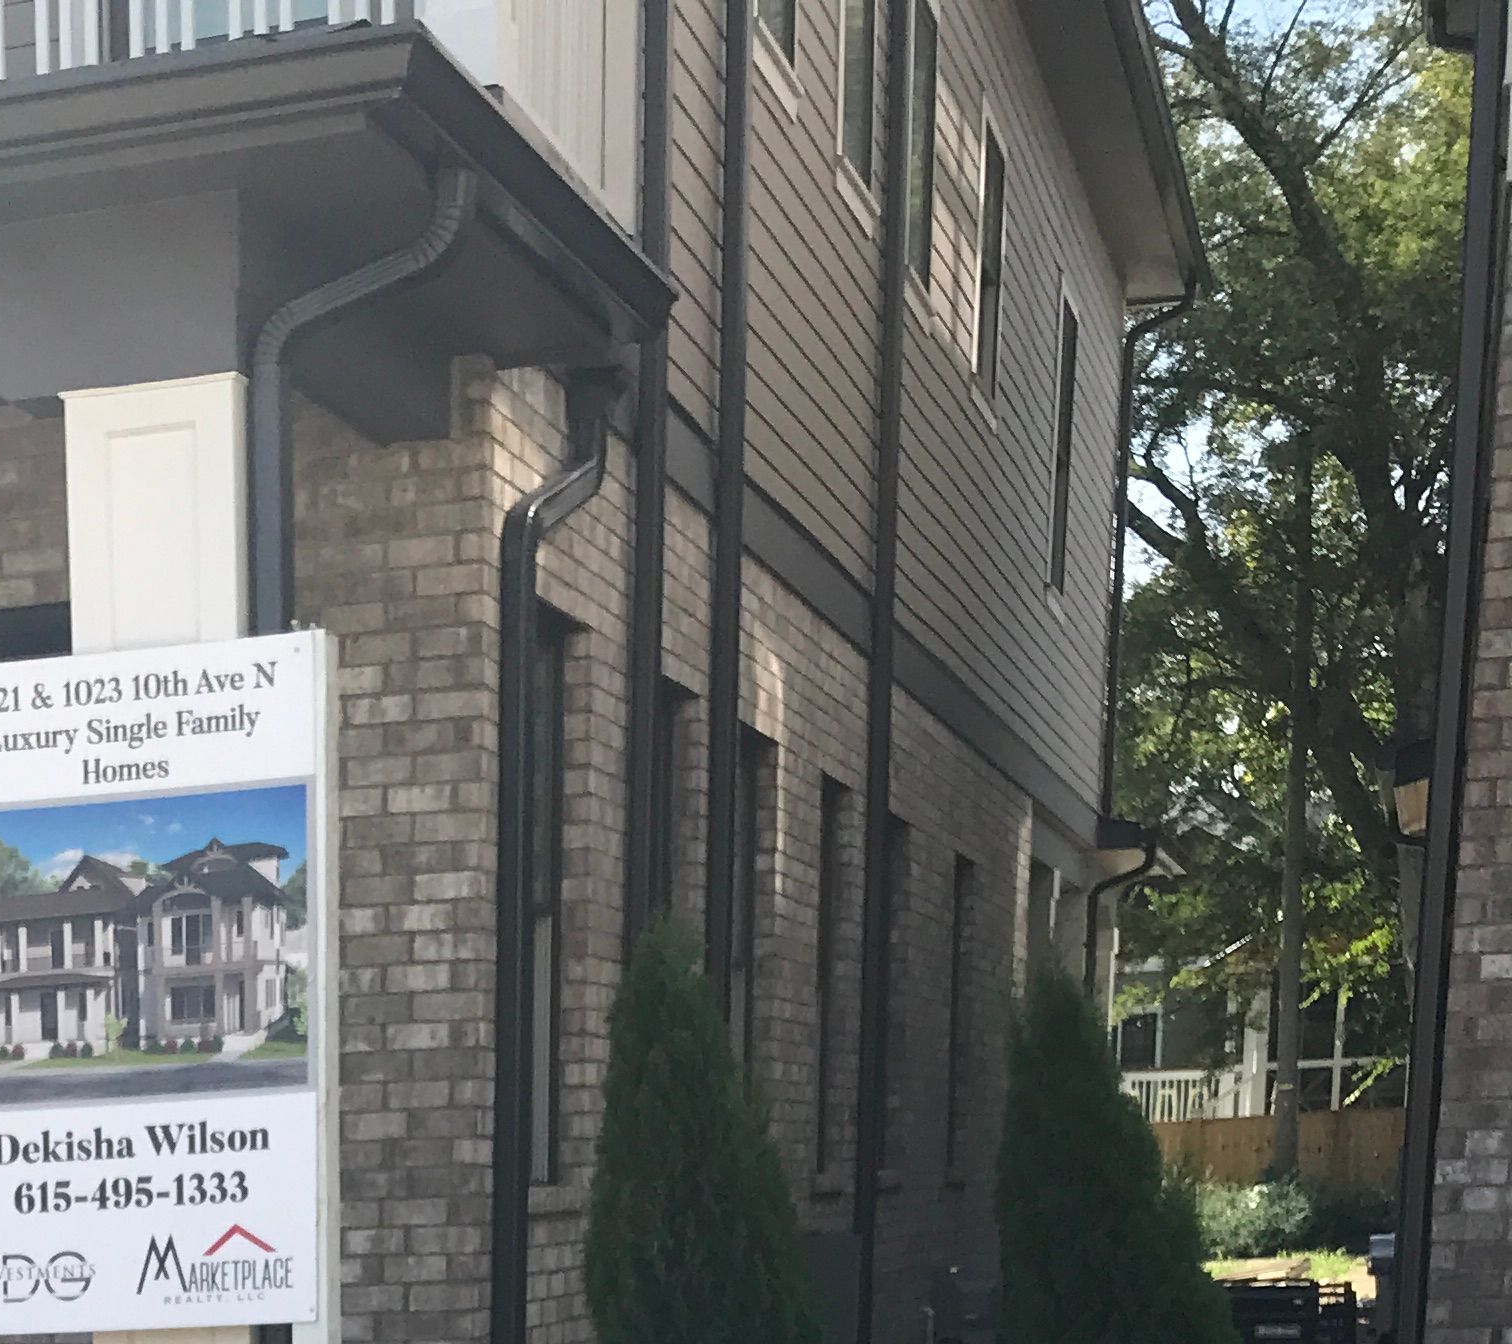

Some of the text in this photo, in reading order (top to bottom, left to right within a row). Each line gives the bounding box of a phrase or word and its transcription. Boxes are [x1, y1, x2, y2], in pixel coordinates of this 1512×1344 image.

[30, 682, 55, 710] &
[63, 677, 123, 707] 1023
[131, 670, 189, 701] 10th
[195, 668, 245, 695] Ave
[253, 661, 278, 689] N
[86, 712, 167, 749] Single
[176, 704, 260, 738] Family
[82, 757, 170, 785] Homes
[144, 1118, 271, 1157] Wilson
[14, 1169, 250, 1215] 615-495-1333
[136, 1232, 294, 1295] MARKETPLACE
[237, 1292, 265, 1302] LLC
